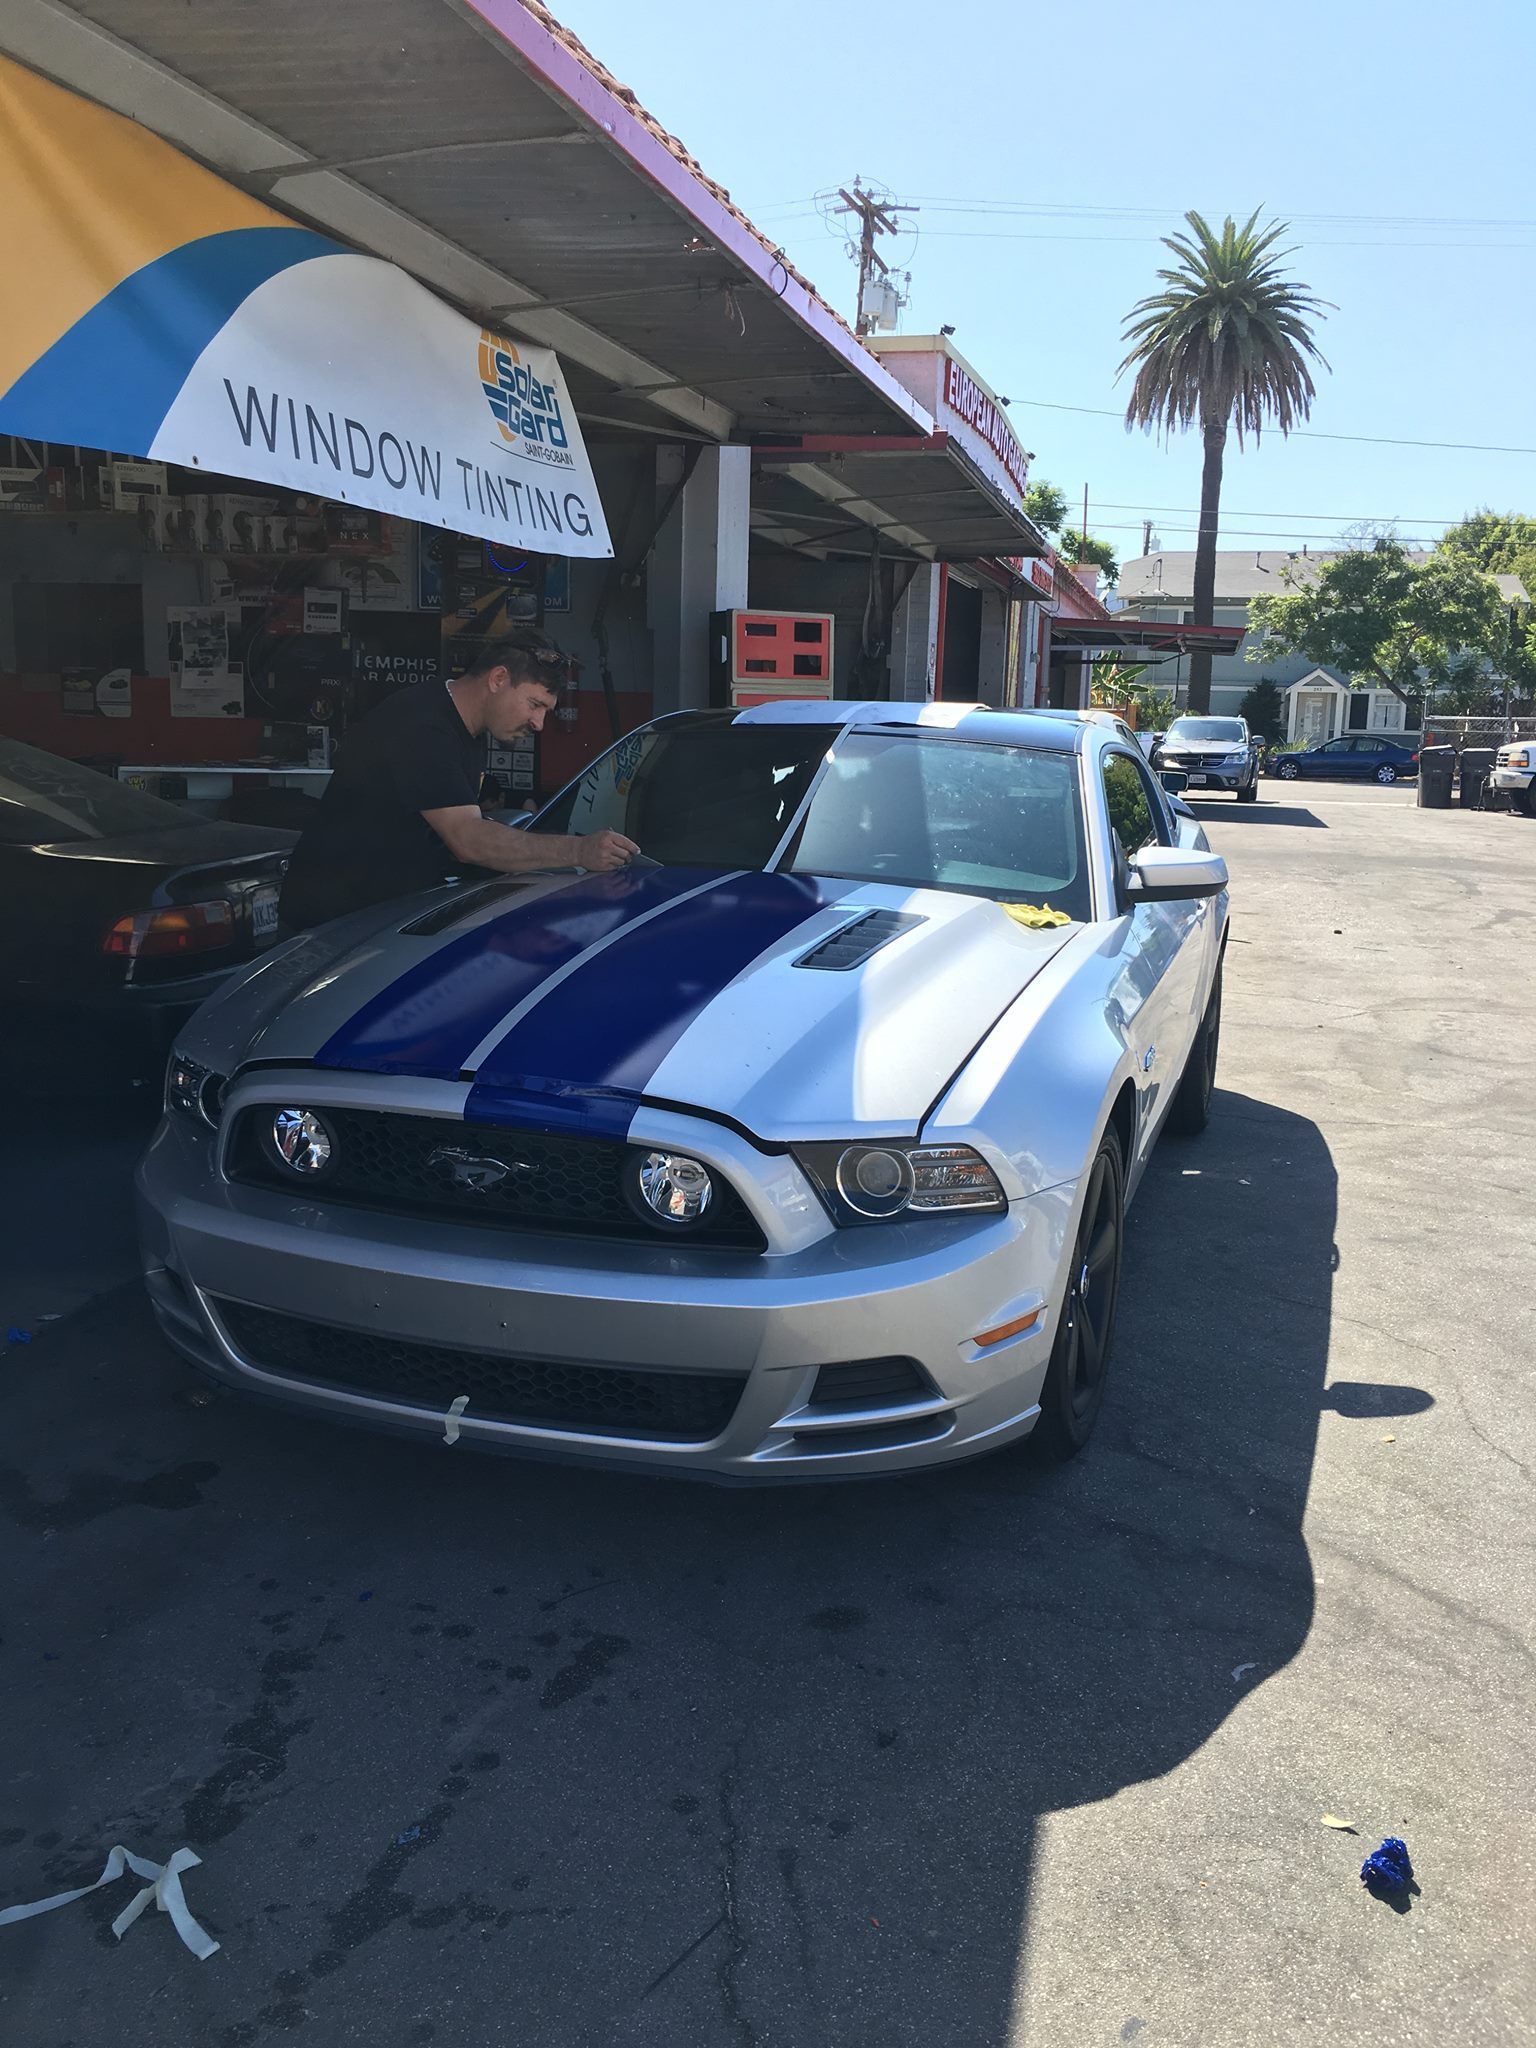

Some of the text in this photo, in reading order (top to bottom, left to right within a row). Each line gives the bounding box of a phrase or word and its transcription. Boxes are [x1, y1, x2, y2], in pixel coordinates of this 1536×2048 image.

[495, 351, 556, 413] Solar
[948, 359, 993, 439] EUROPEAN
[991, 407, 1009, 460] AUTO
[507, 395, 569, 449] Gard
[223, 377, 593, 538] WINDOW TINTING
[524, 441, 574, 466] SAINT-GOBAIN
